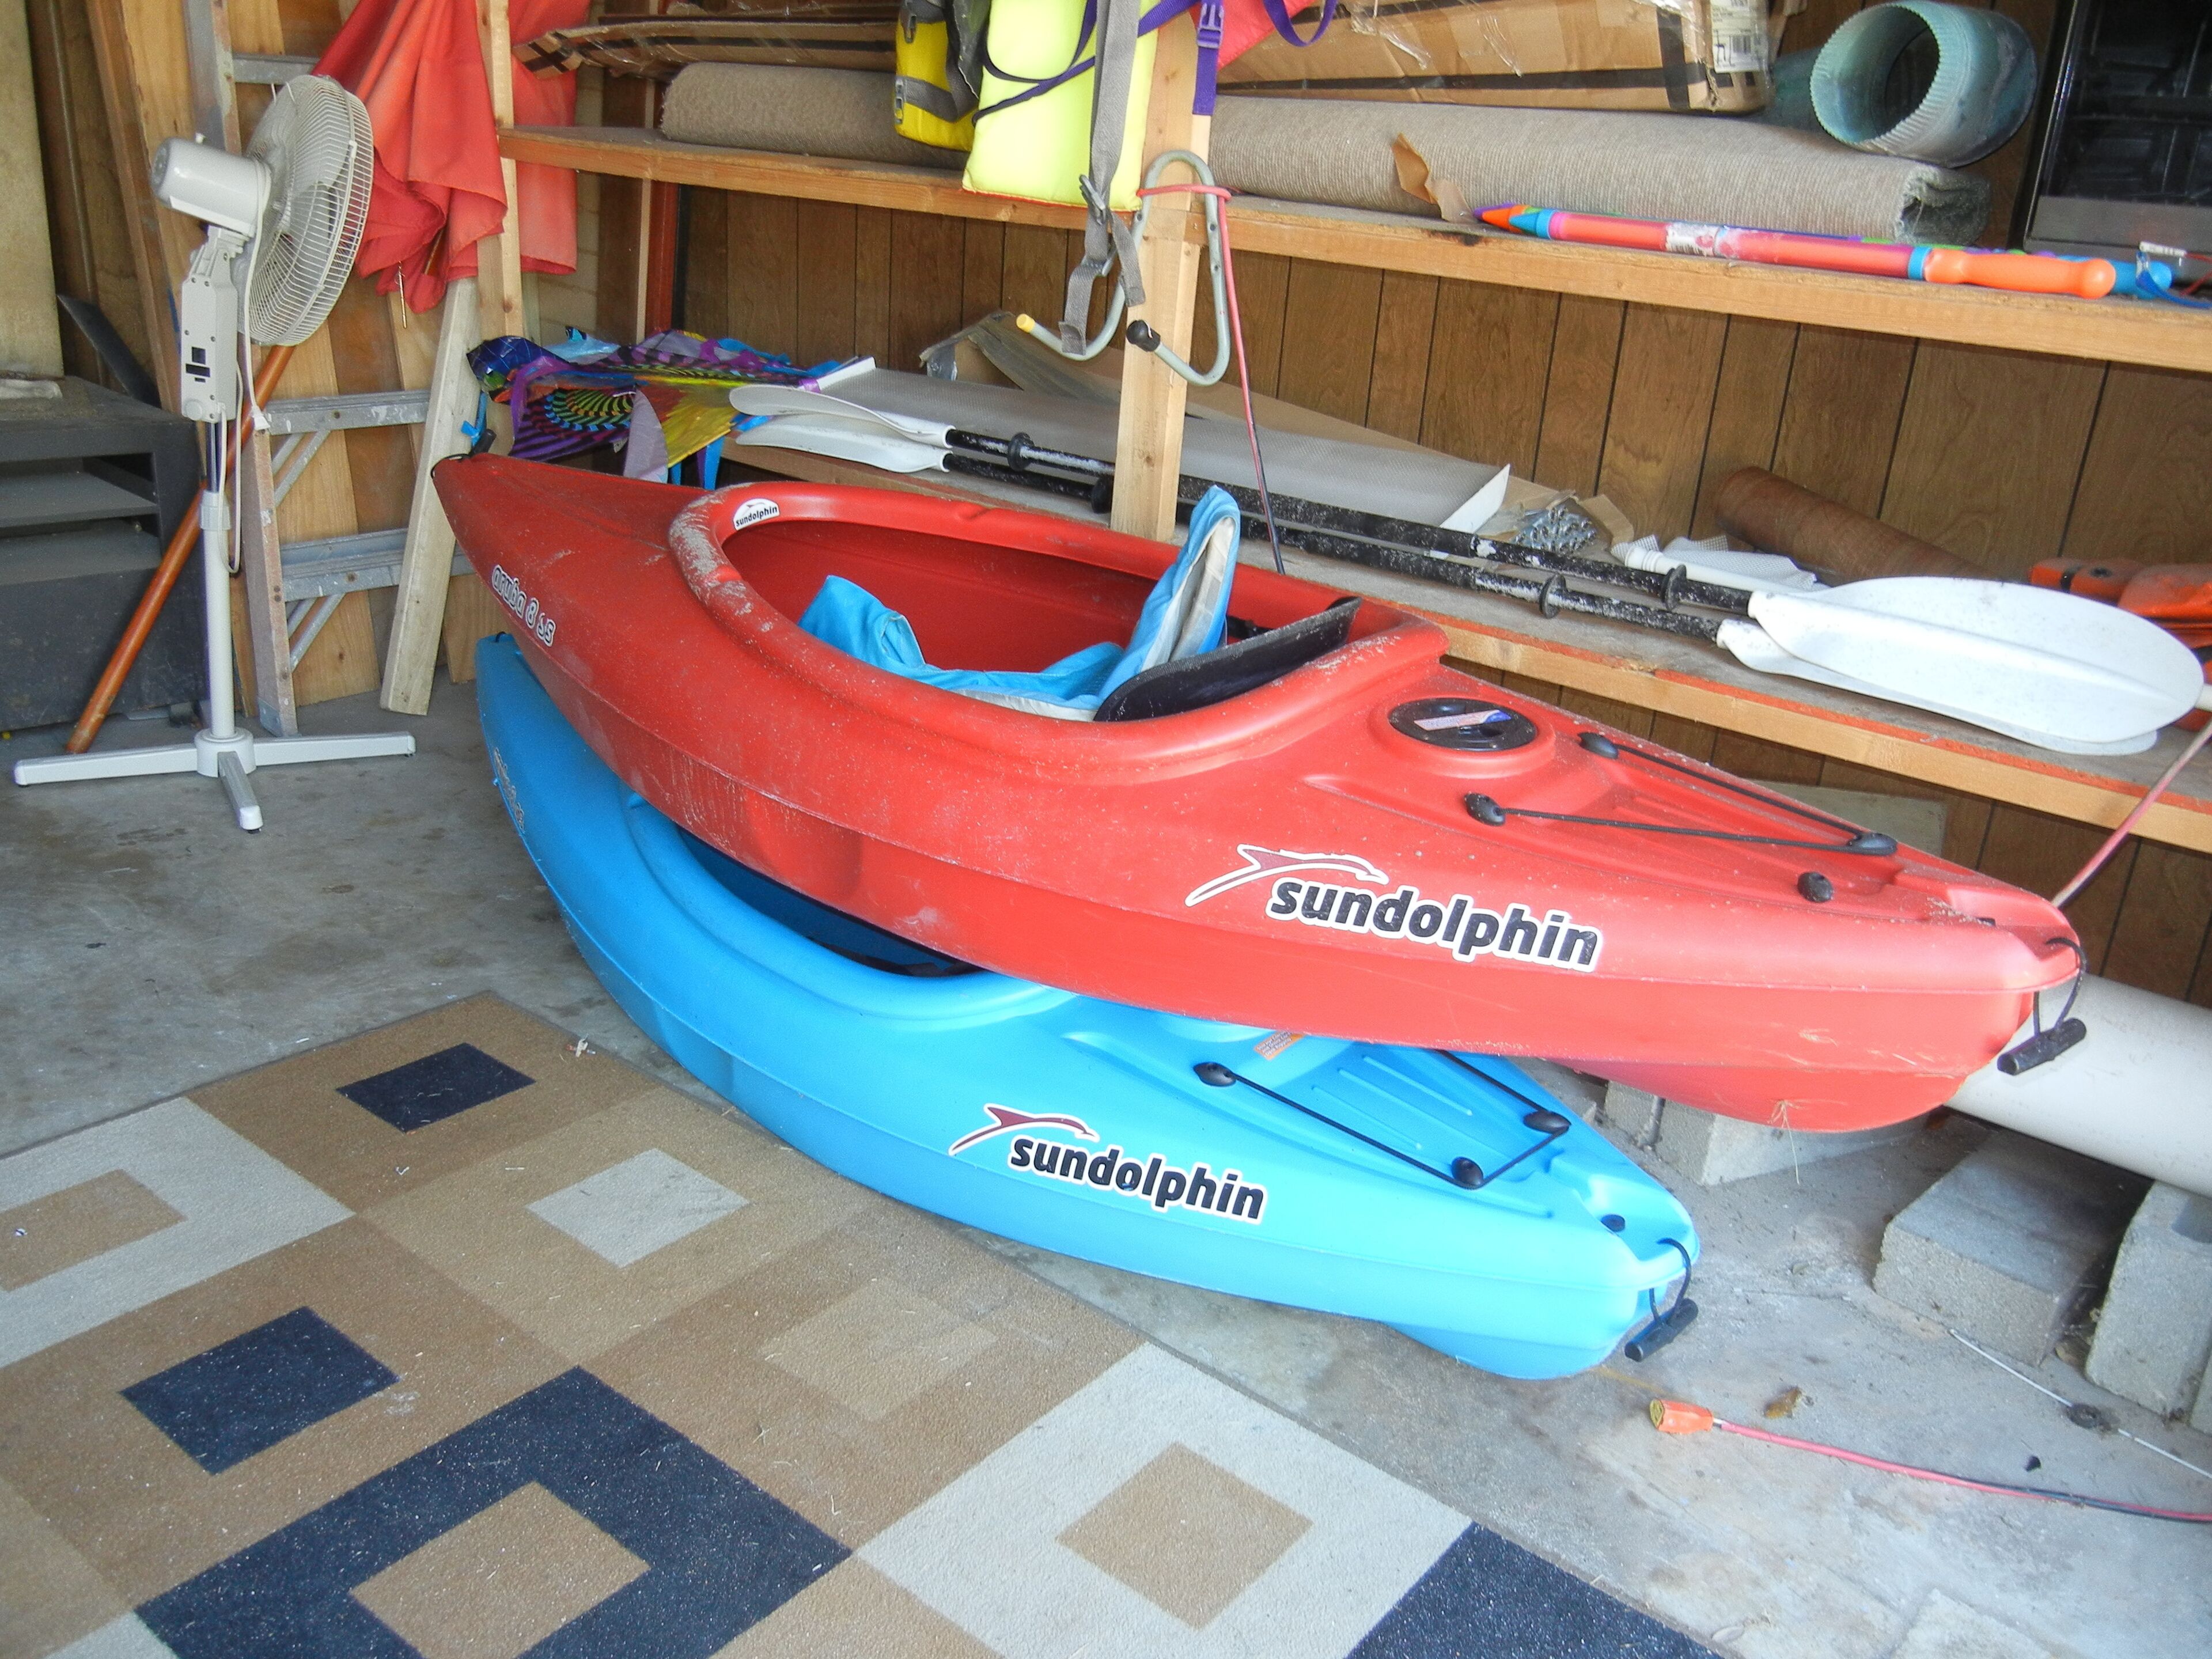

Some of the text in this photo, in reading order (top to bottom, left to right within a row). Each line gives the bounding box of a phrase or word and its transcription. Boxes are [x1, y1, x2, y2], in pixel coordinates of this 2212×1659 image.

[736, 506, 778, 527] sundolphin
[493, 566, 525, 618] aruba
[527, 599, 539, 628] 8
[1270, 881, 1599, 965] sundolphin
[1010, 1138, 1264, 1219] sundolphin
